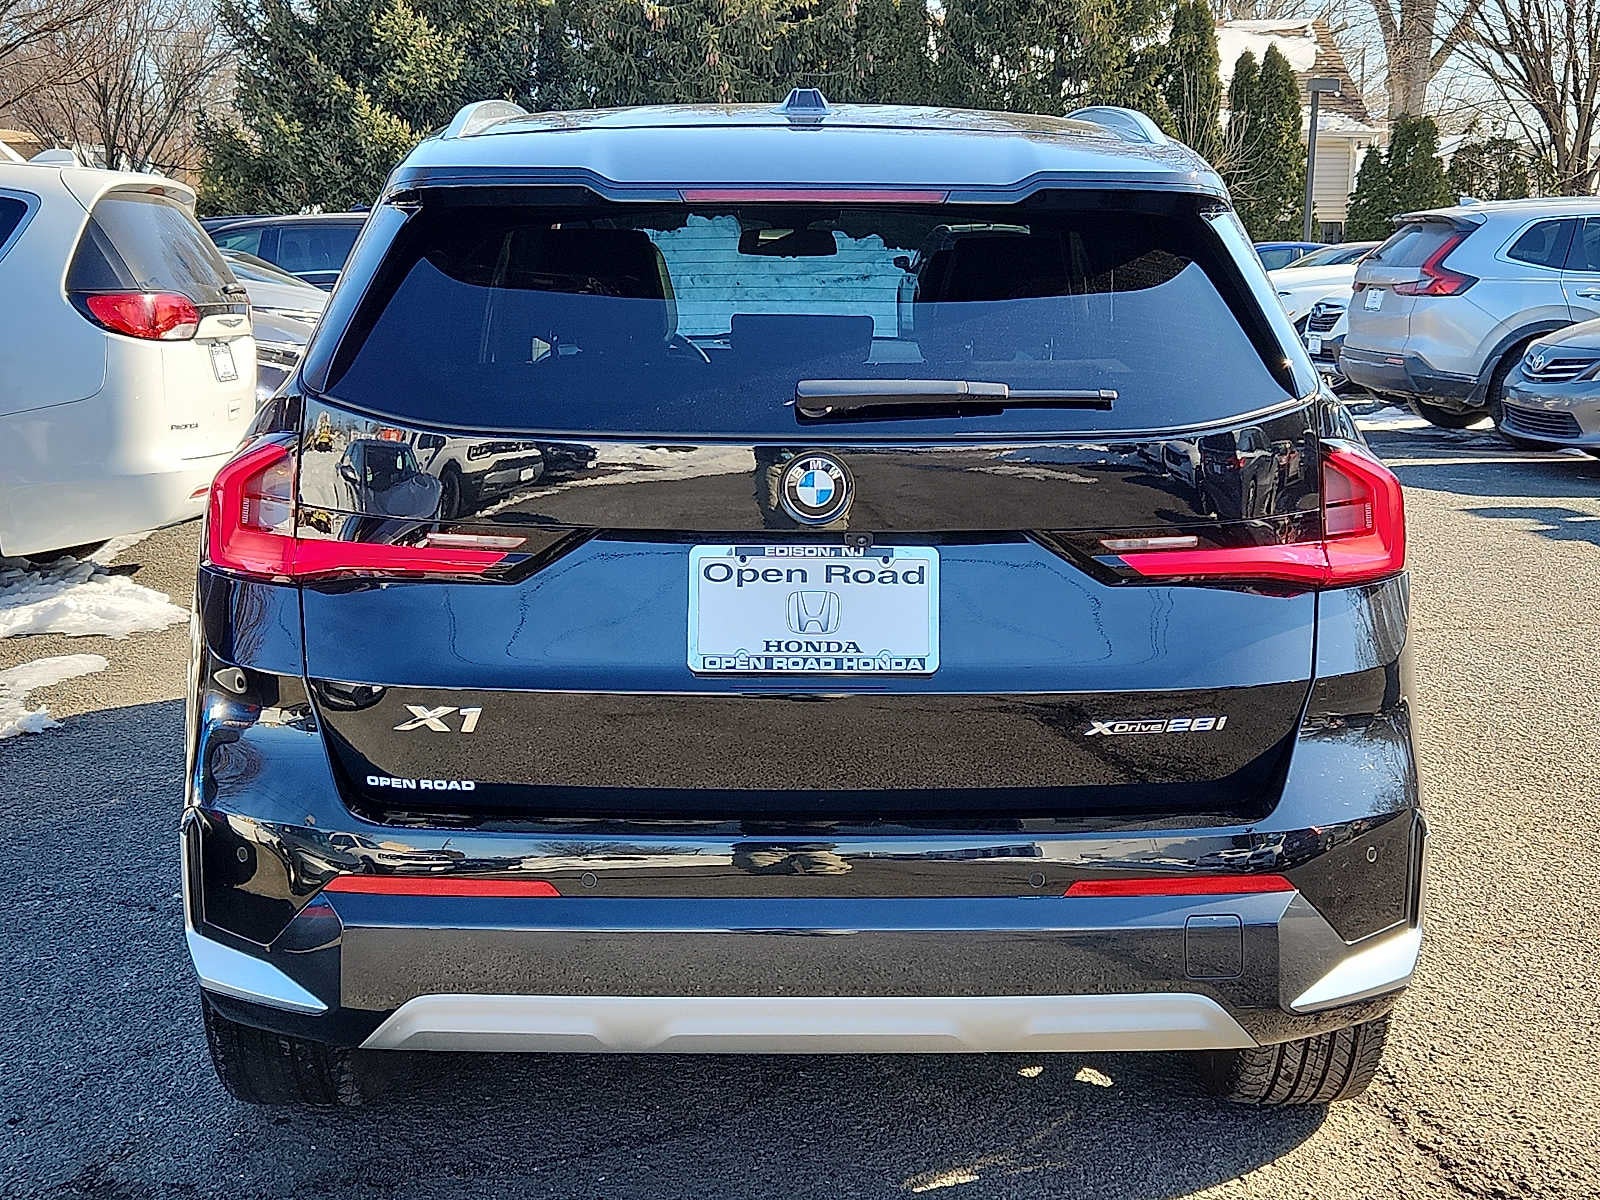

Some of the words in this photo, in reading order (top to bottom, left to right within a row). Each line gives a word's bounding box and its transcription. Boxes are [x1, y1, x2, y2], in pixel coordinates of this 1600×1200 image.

[790, 459, 841, 481] BMW
[765, 546, 836, 557] EDISON,
[841, 546, 865, 557] NJ
[703, 563, 808, 587] Open
[825, 565, 925, 585] Road
[763, 640, 864, 654] HONDA
[704, 657, 766, 670] OPEN
[773, 657, 836, 671] ROAD
[843, 657, 923, 671] HONDA
[393, 704, 483, 733] X1
[367, 775, 417, 790] OPEN
[419, 778, 476, 792] ROAD
